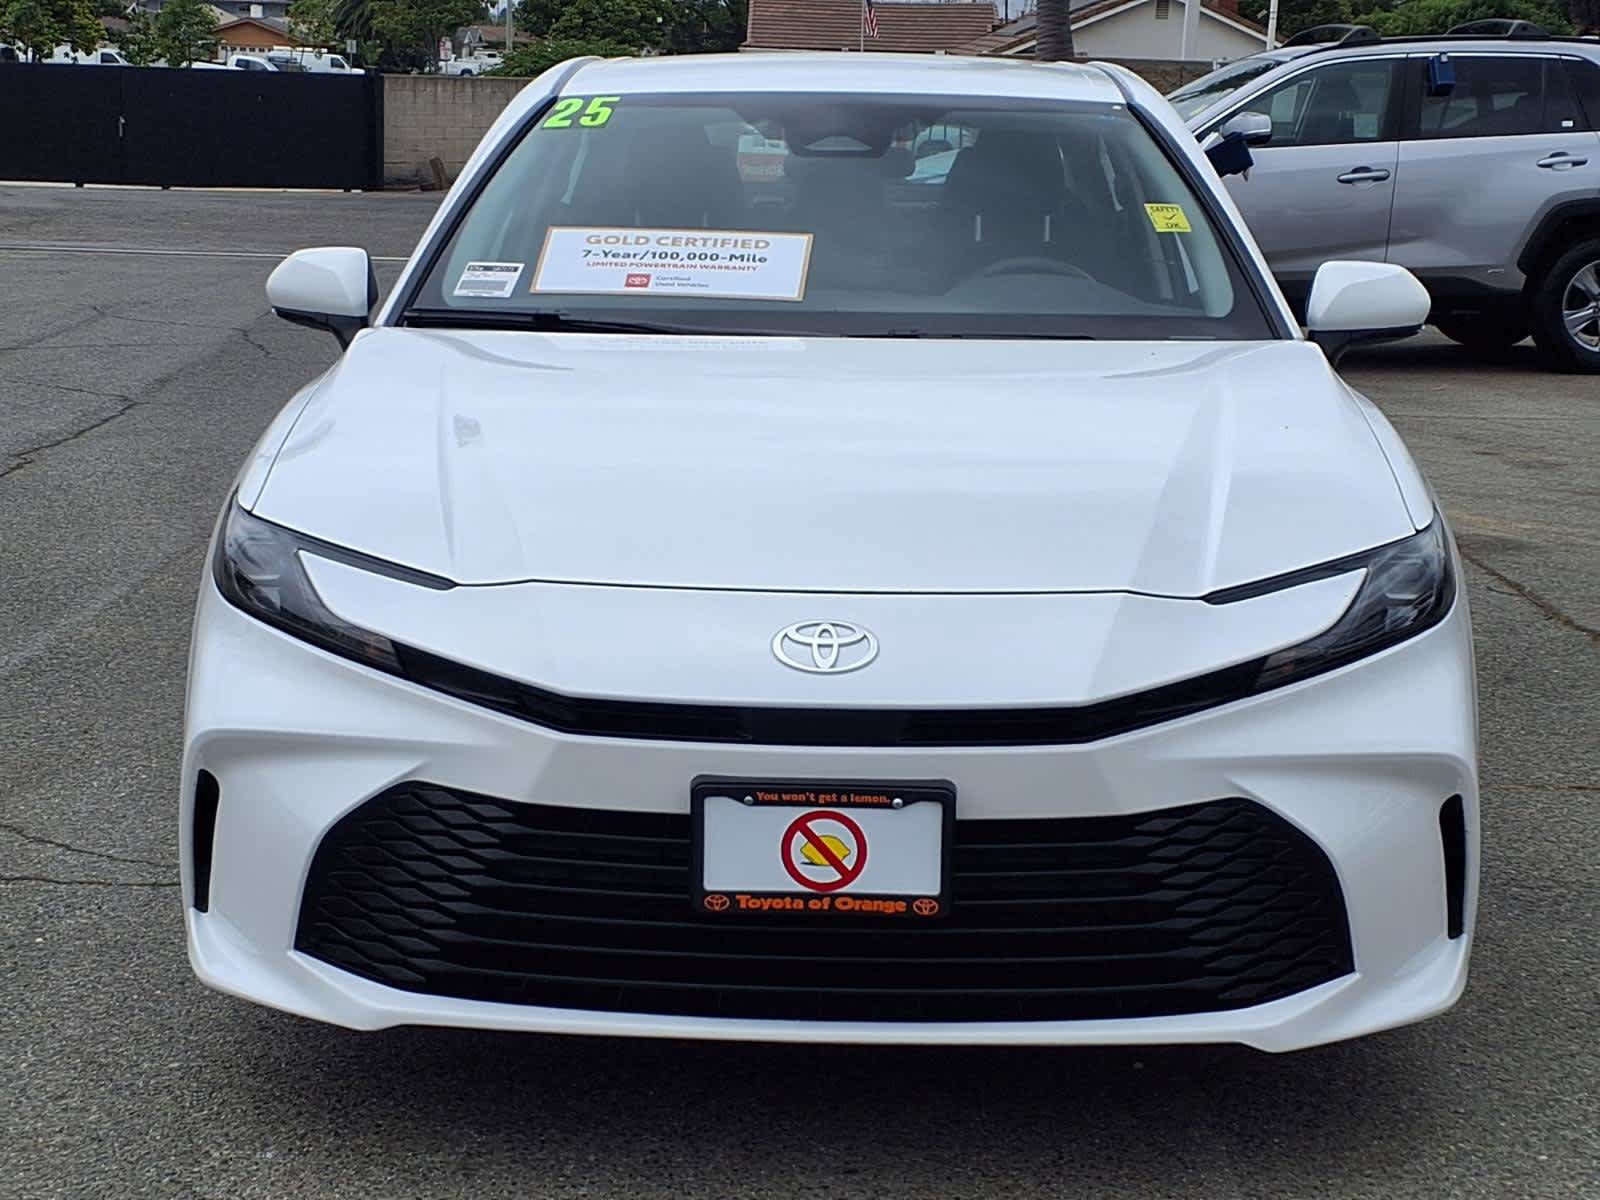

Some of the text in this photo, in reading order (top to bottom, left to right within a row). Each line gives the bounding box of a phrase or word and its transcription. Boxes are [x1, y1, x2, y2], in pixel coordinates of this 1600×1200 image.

[544, 96, 621, 128] 25
[586, 235, 770, 250] GOLD CERTIFIED
[582, 249, 768, 264] 7-Year/100,000-Mile
[628, 262, 698, 270] POWERTRAIN
[699, 264, 759, 272] WARRANTY
[756, 791, 778, 801] You
[781, 791, 815, 803] won't
[818, 793, 837, 804] get
[850, 793, 890, 804] lemon.
[735, 894, 907, 914] Toyota of Orange
